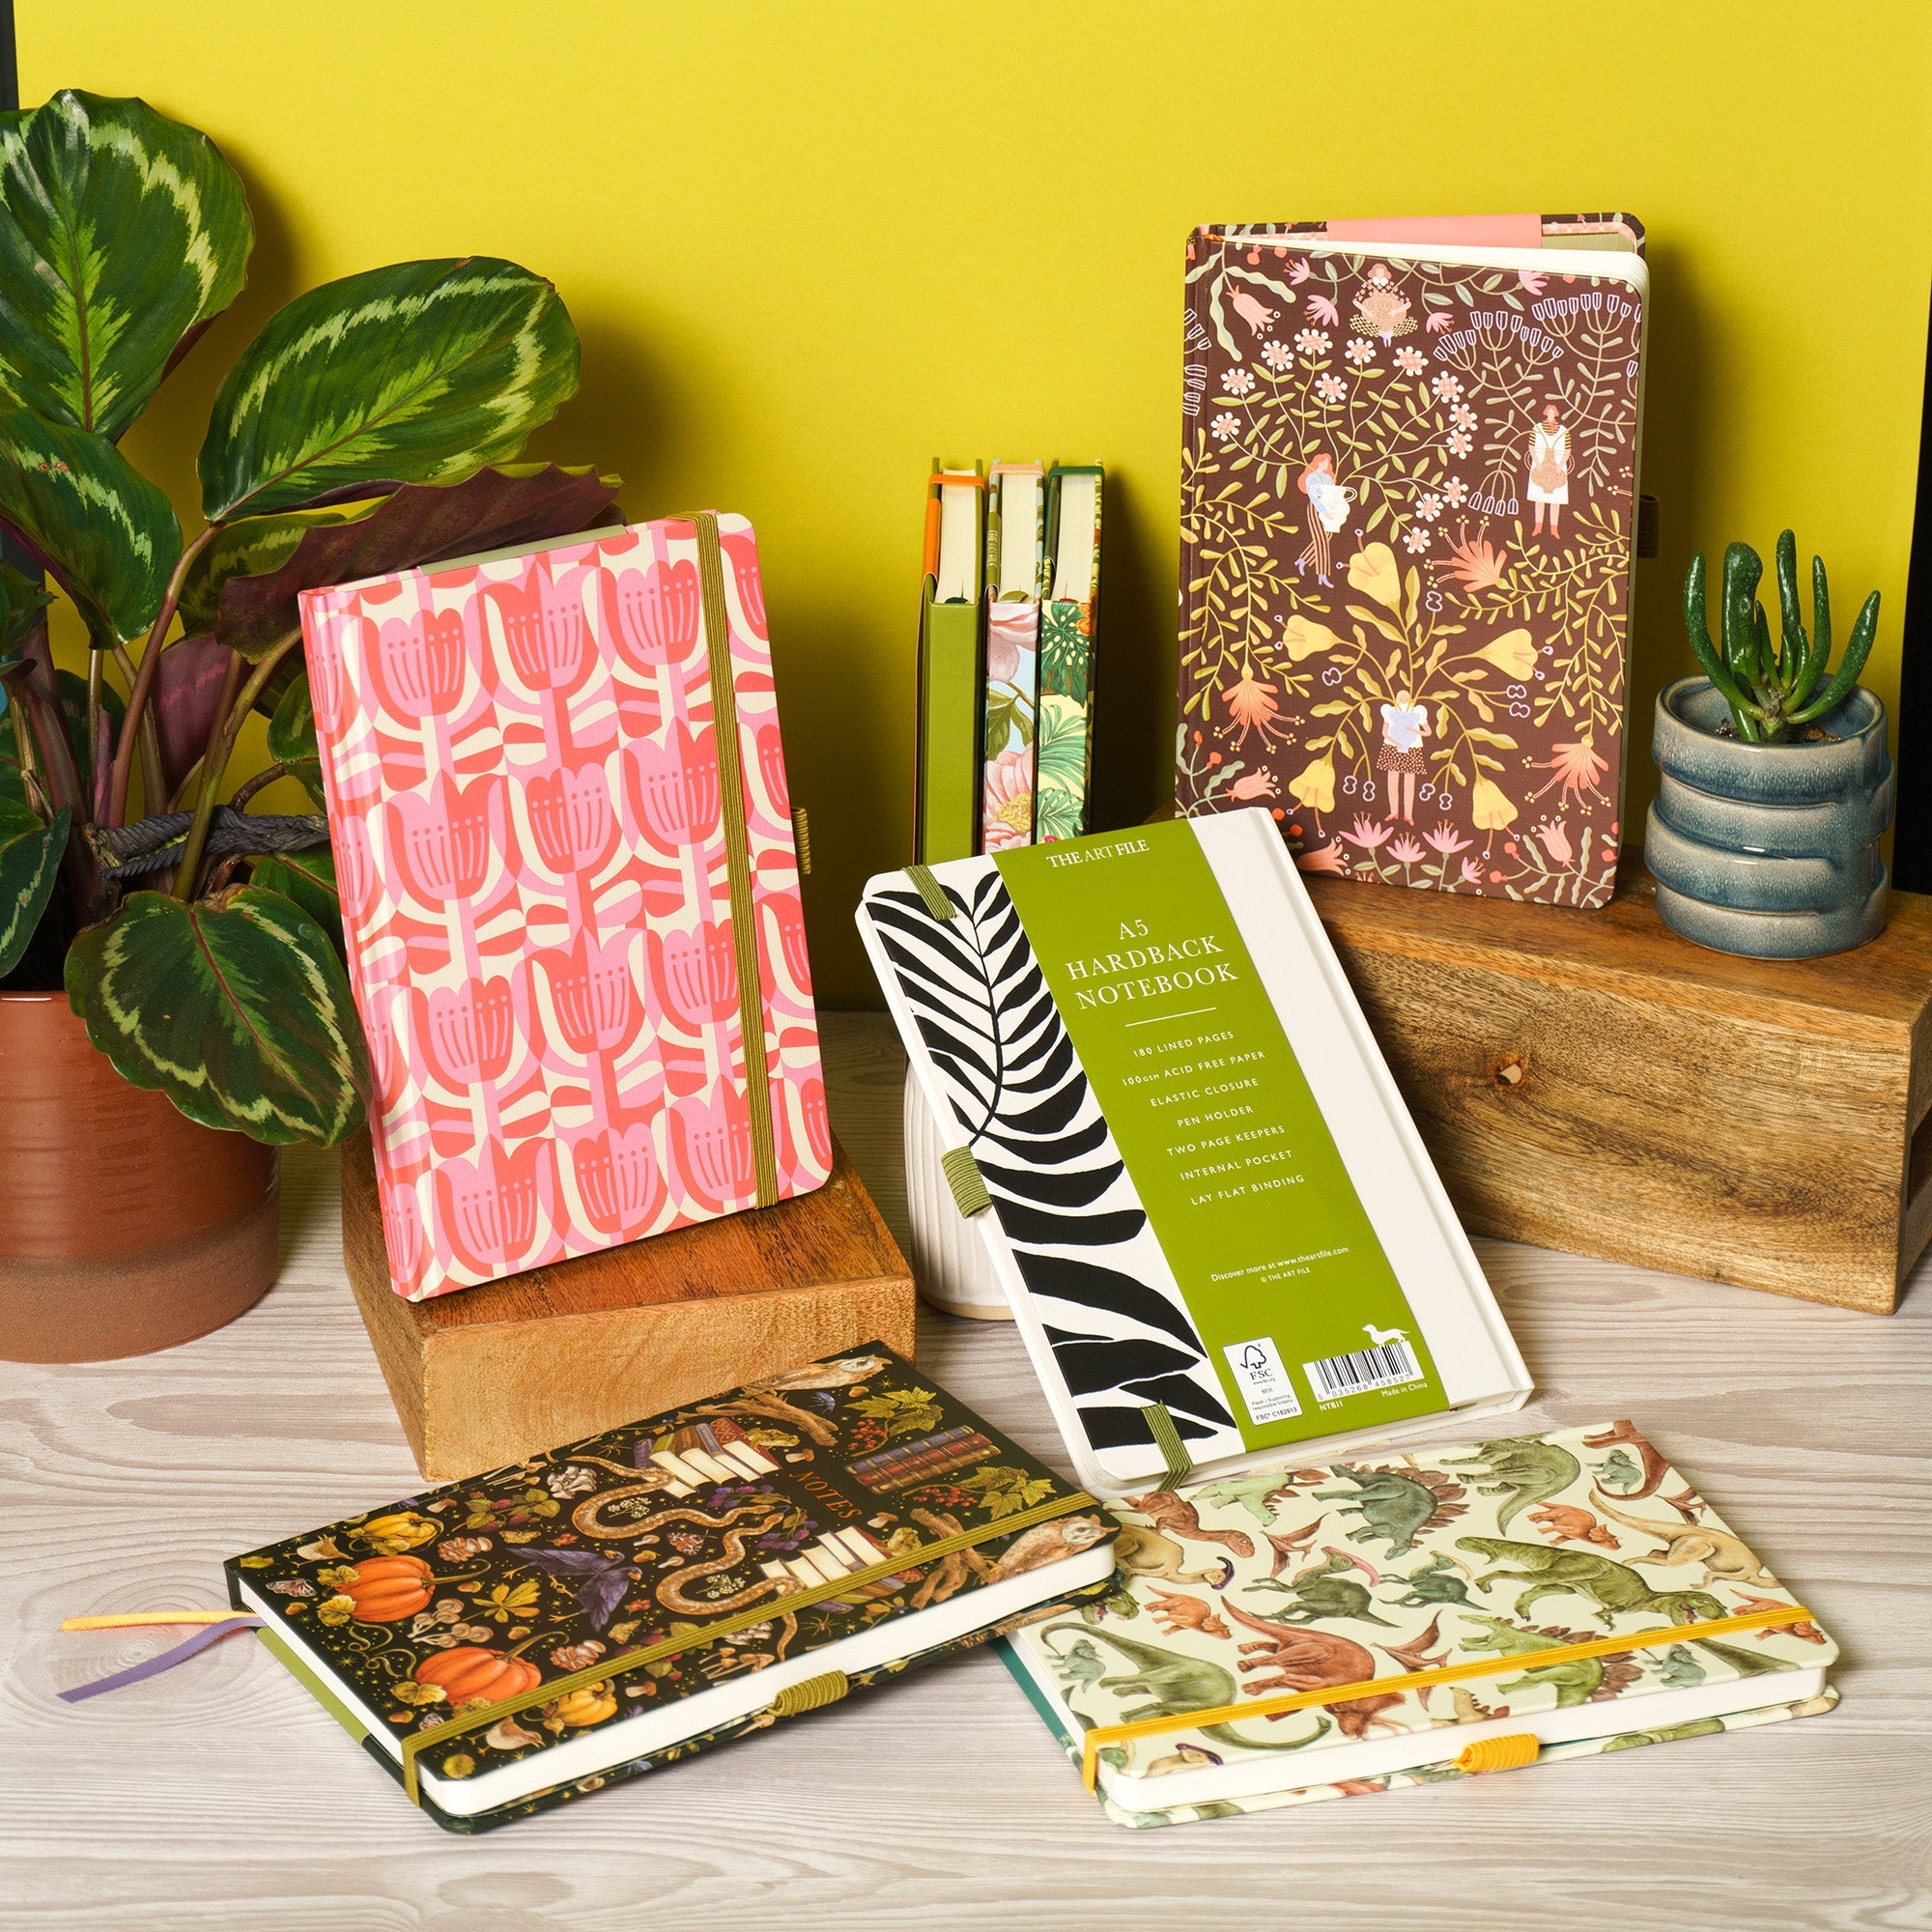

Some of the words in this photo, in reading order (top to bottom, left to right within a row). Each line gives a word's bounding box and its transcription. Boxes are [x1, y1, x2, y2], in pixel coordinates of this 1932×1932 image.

[1046, 851, 1084, 868] THE
[1085, 845, 1114, 863] ART
[1114, 838, 1150, 857] FILE
[1119, 919, 1149, 941] A5
[1065, 935, 1224, 981] HARDBACK
[1074, 962, 1238, 1010] NOTEBOOK
[1133, 1047, 1153, 1058] 180
[1156, 1038, 1194, 1054] LINED
[1197, 1031, 1235, 1045] PAGES
[1164, 1064, 1194, 1078] ACID
[1198, 1058, 1226, 1070] FREE
[1230, 1050, 1265, 1065] PAPER
[1150, 1089, 1201, 1107] ELASTIC
[1205, 1077, 1260, 1095] CLOSURE
[1177, 1116, 1201, 1128] PEN
[1205, 1105, 1254, 1122] HOLDER
[1167, 1143, 1196, 1157] TWO
[1201, 1135, 1232, 1150] PAGE
[1236, 1124, 1286, 1142] KEEPERS
[1179, 1160, 1242, 1181] INTERNAL
[1245, 1150, 1293, 1166] POCKET
[1190, 1193, 1212, 1207] LAY
[1217, 1185, 1246, 1200] FLAT
[1251, 1174, 1305, 1193] BINDING
[1209, 1268, 1244, 1283] Discover
[1246, 1264, 1267, 1274] more
[1276, 1245, 1350, 1268] www.theartfile.com
[1267, 1272, 1282, 1282] THE
[1283, 1269, 1297, 1279] ART
[1296, 1266, 1312, 1276] FILE
[1249, 1368, 1273, 1380] FSC
[1331, 1383, 1370, 1398] 035268
[1375, 1375, 1410, 1388] 458527
[1380, 1389, 1400, 1398] Made
[1407, 1382, 1428, 1392] China
[788, 1471, 863, 1520] NOTES
